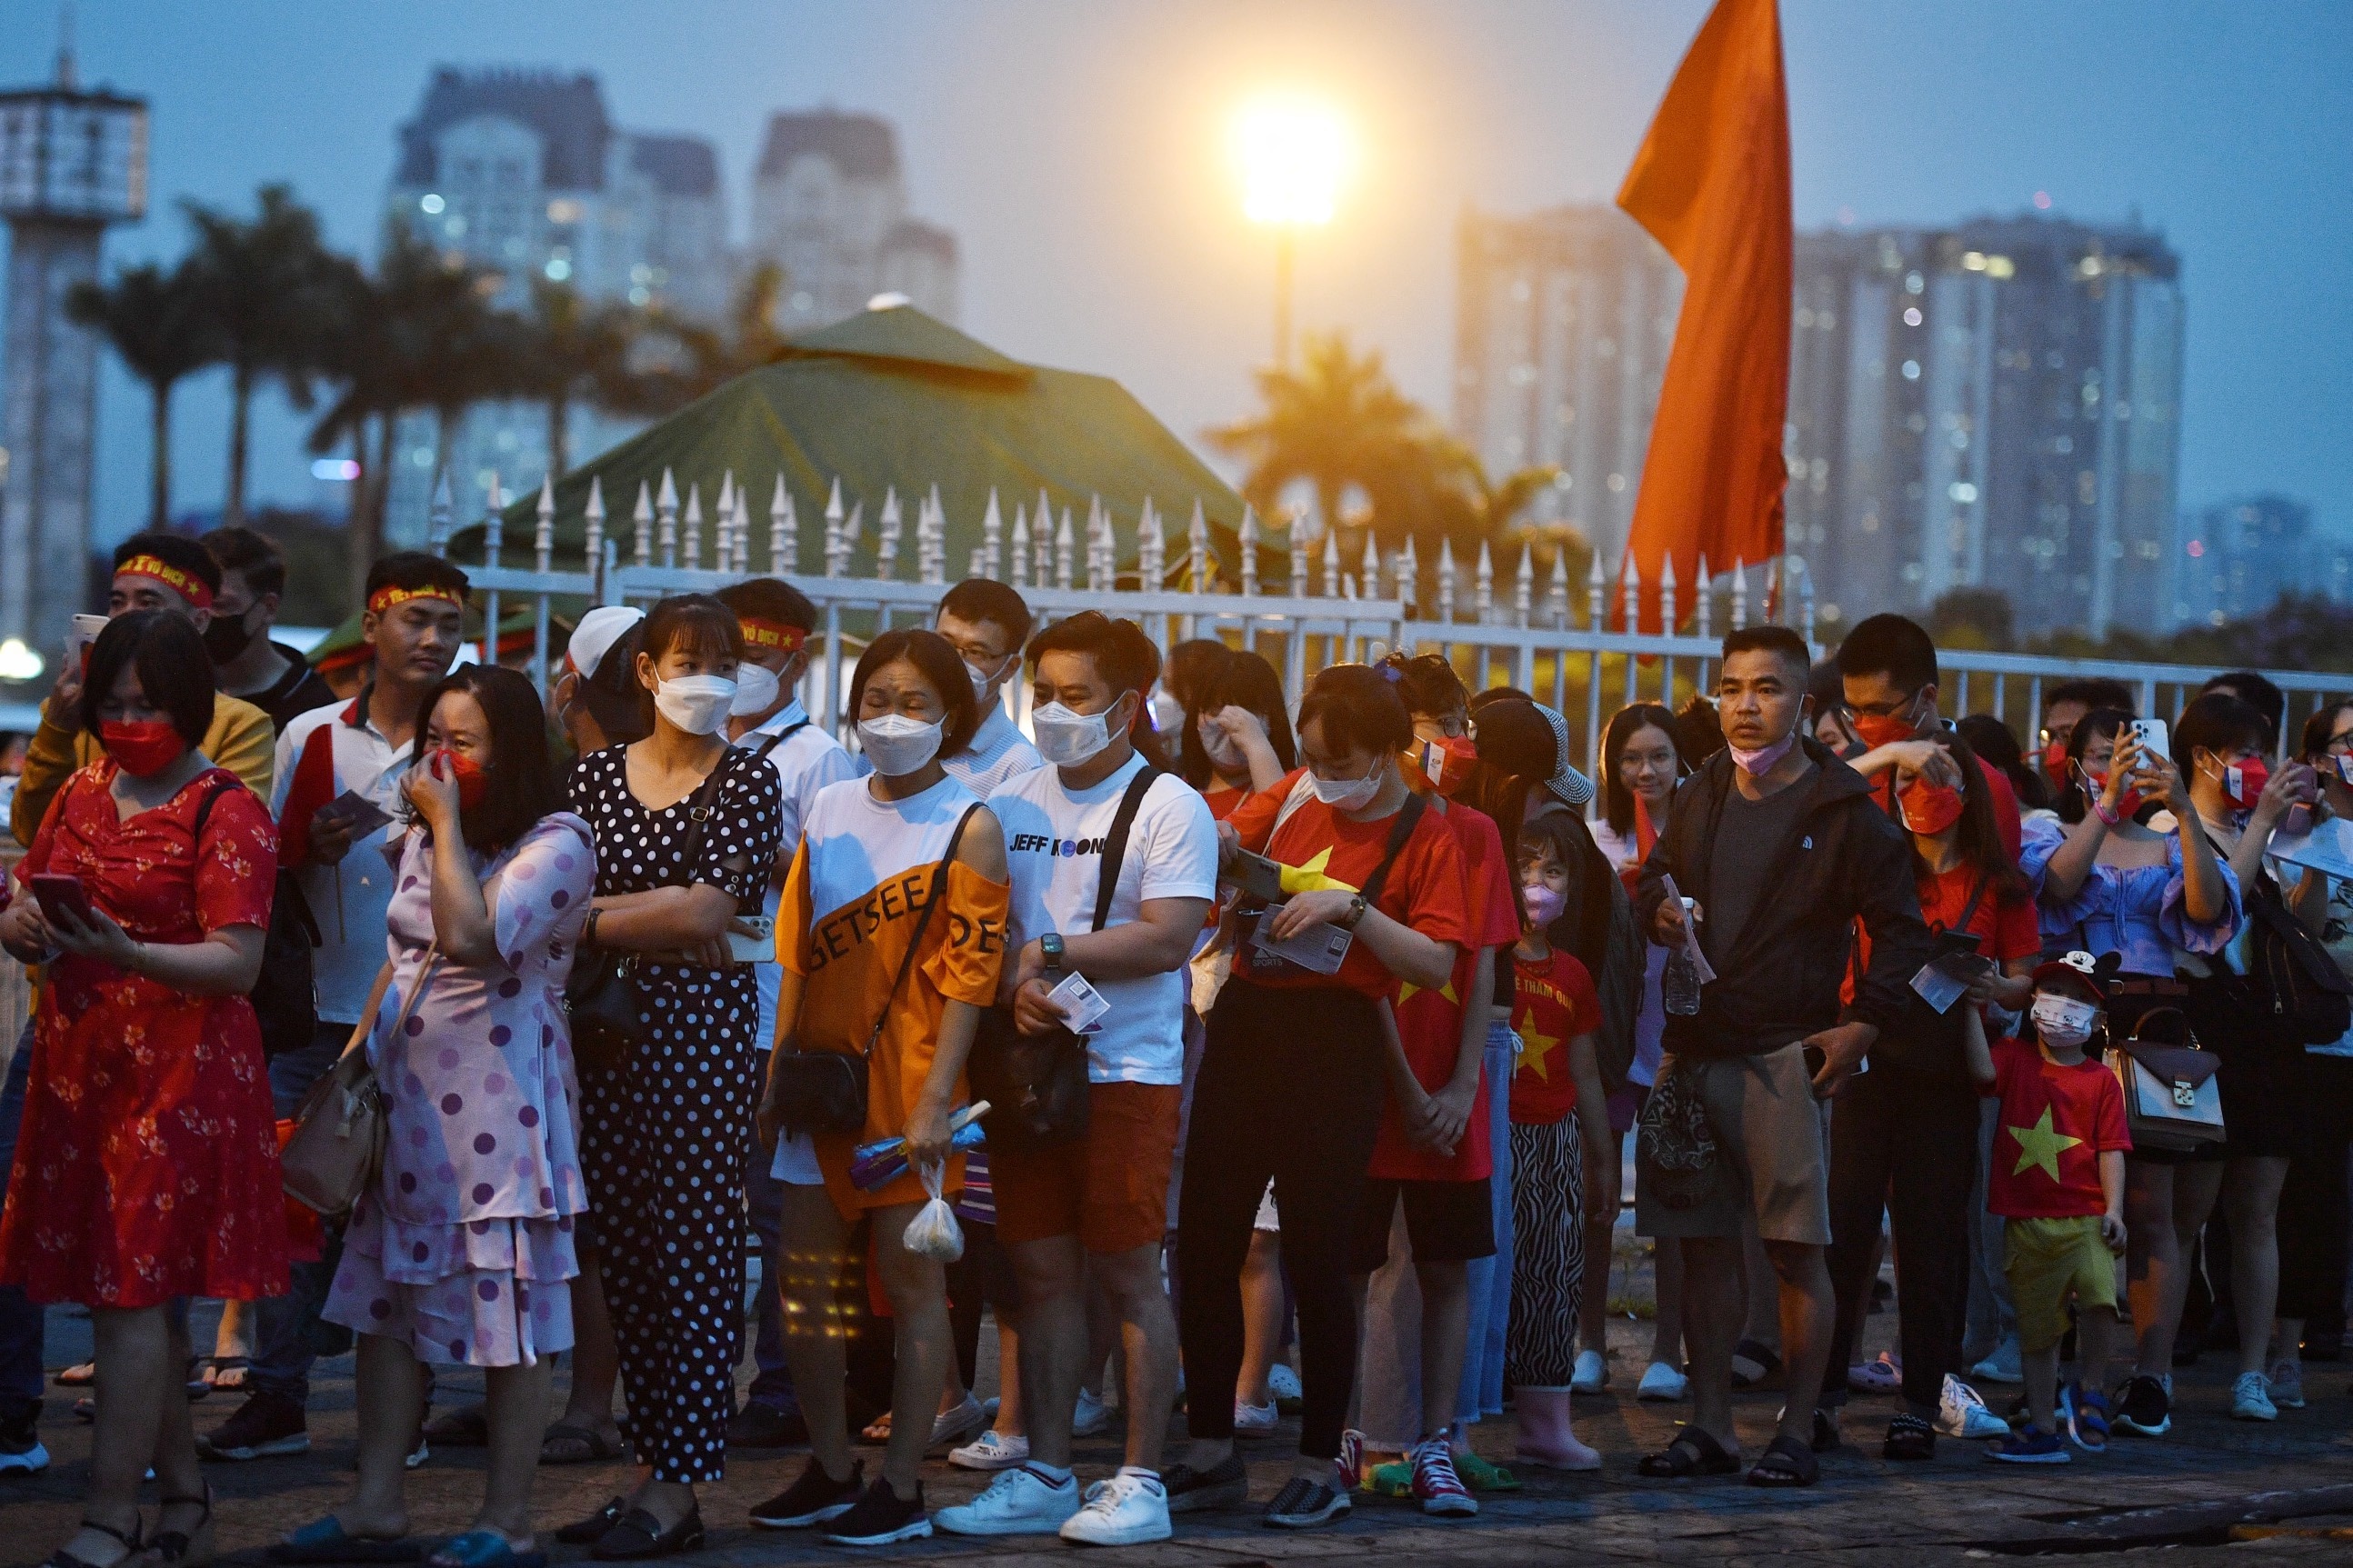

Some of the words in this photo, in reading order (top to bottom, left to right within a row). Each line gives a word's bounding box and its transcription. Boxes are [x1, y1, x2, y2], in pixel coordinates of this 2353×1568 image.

[1009, 834, 1048, 853] JEFF
[1050, 837, 1106, 858] KOON
[1252, 958, 1283, 967] SPORTS
